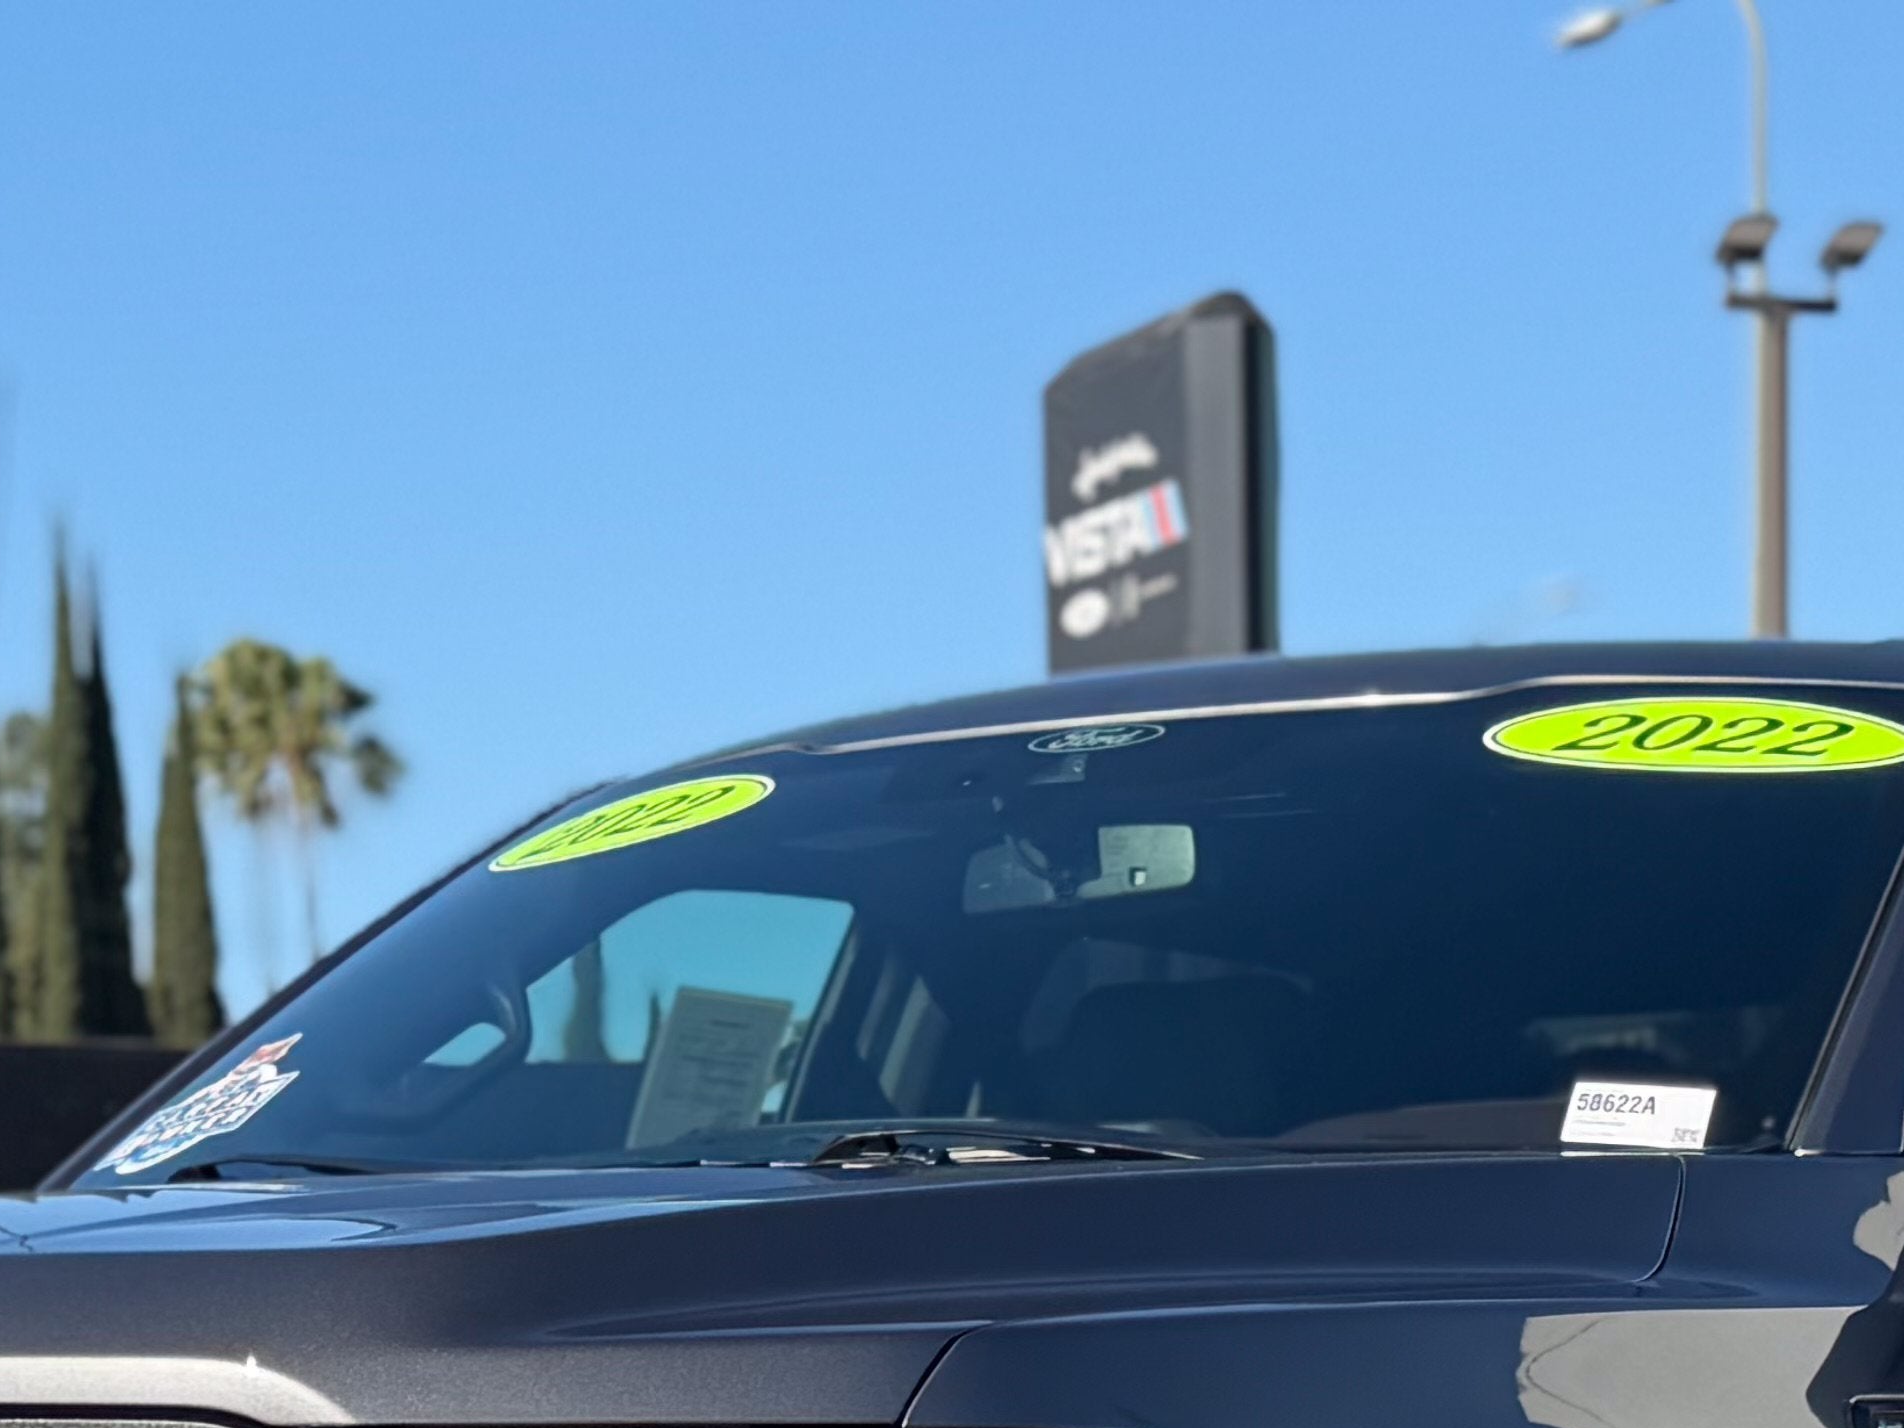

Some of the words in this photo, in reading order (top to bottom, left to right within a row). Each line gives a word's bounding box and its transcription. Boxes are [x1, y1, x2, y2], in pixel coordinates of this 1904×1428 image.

[1047, 726, 1145, 752] Ford
[1553, 711, 1854, 759] 2022
[514, 784, 736, 865] 2022
[1576, 1092, 1656, 1115] 58622A
